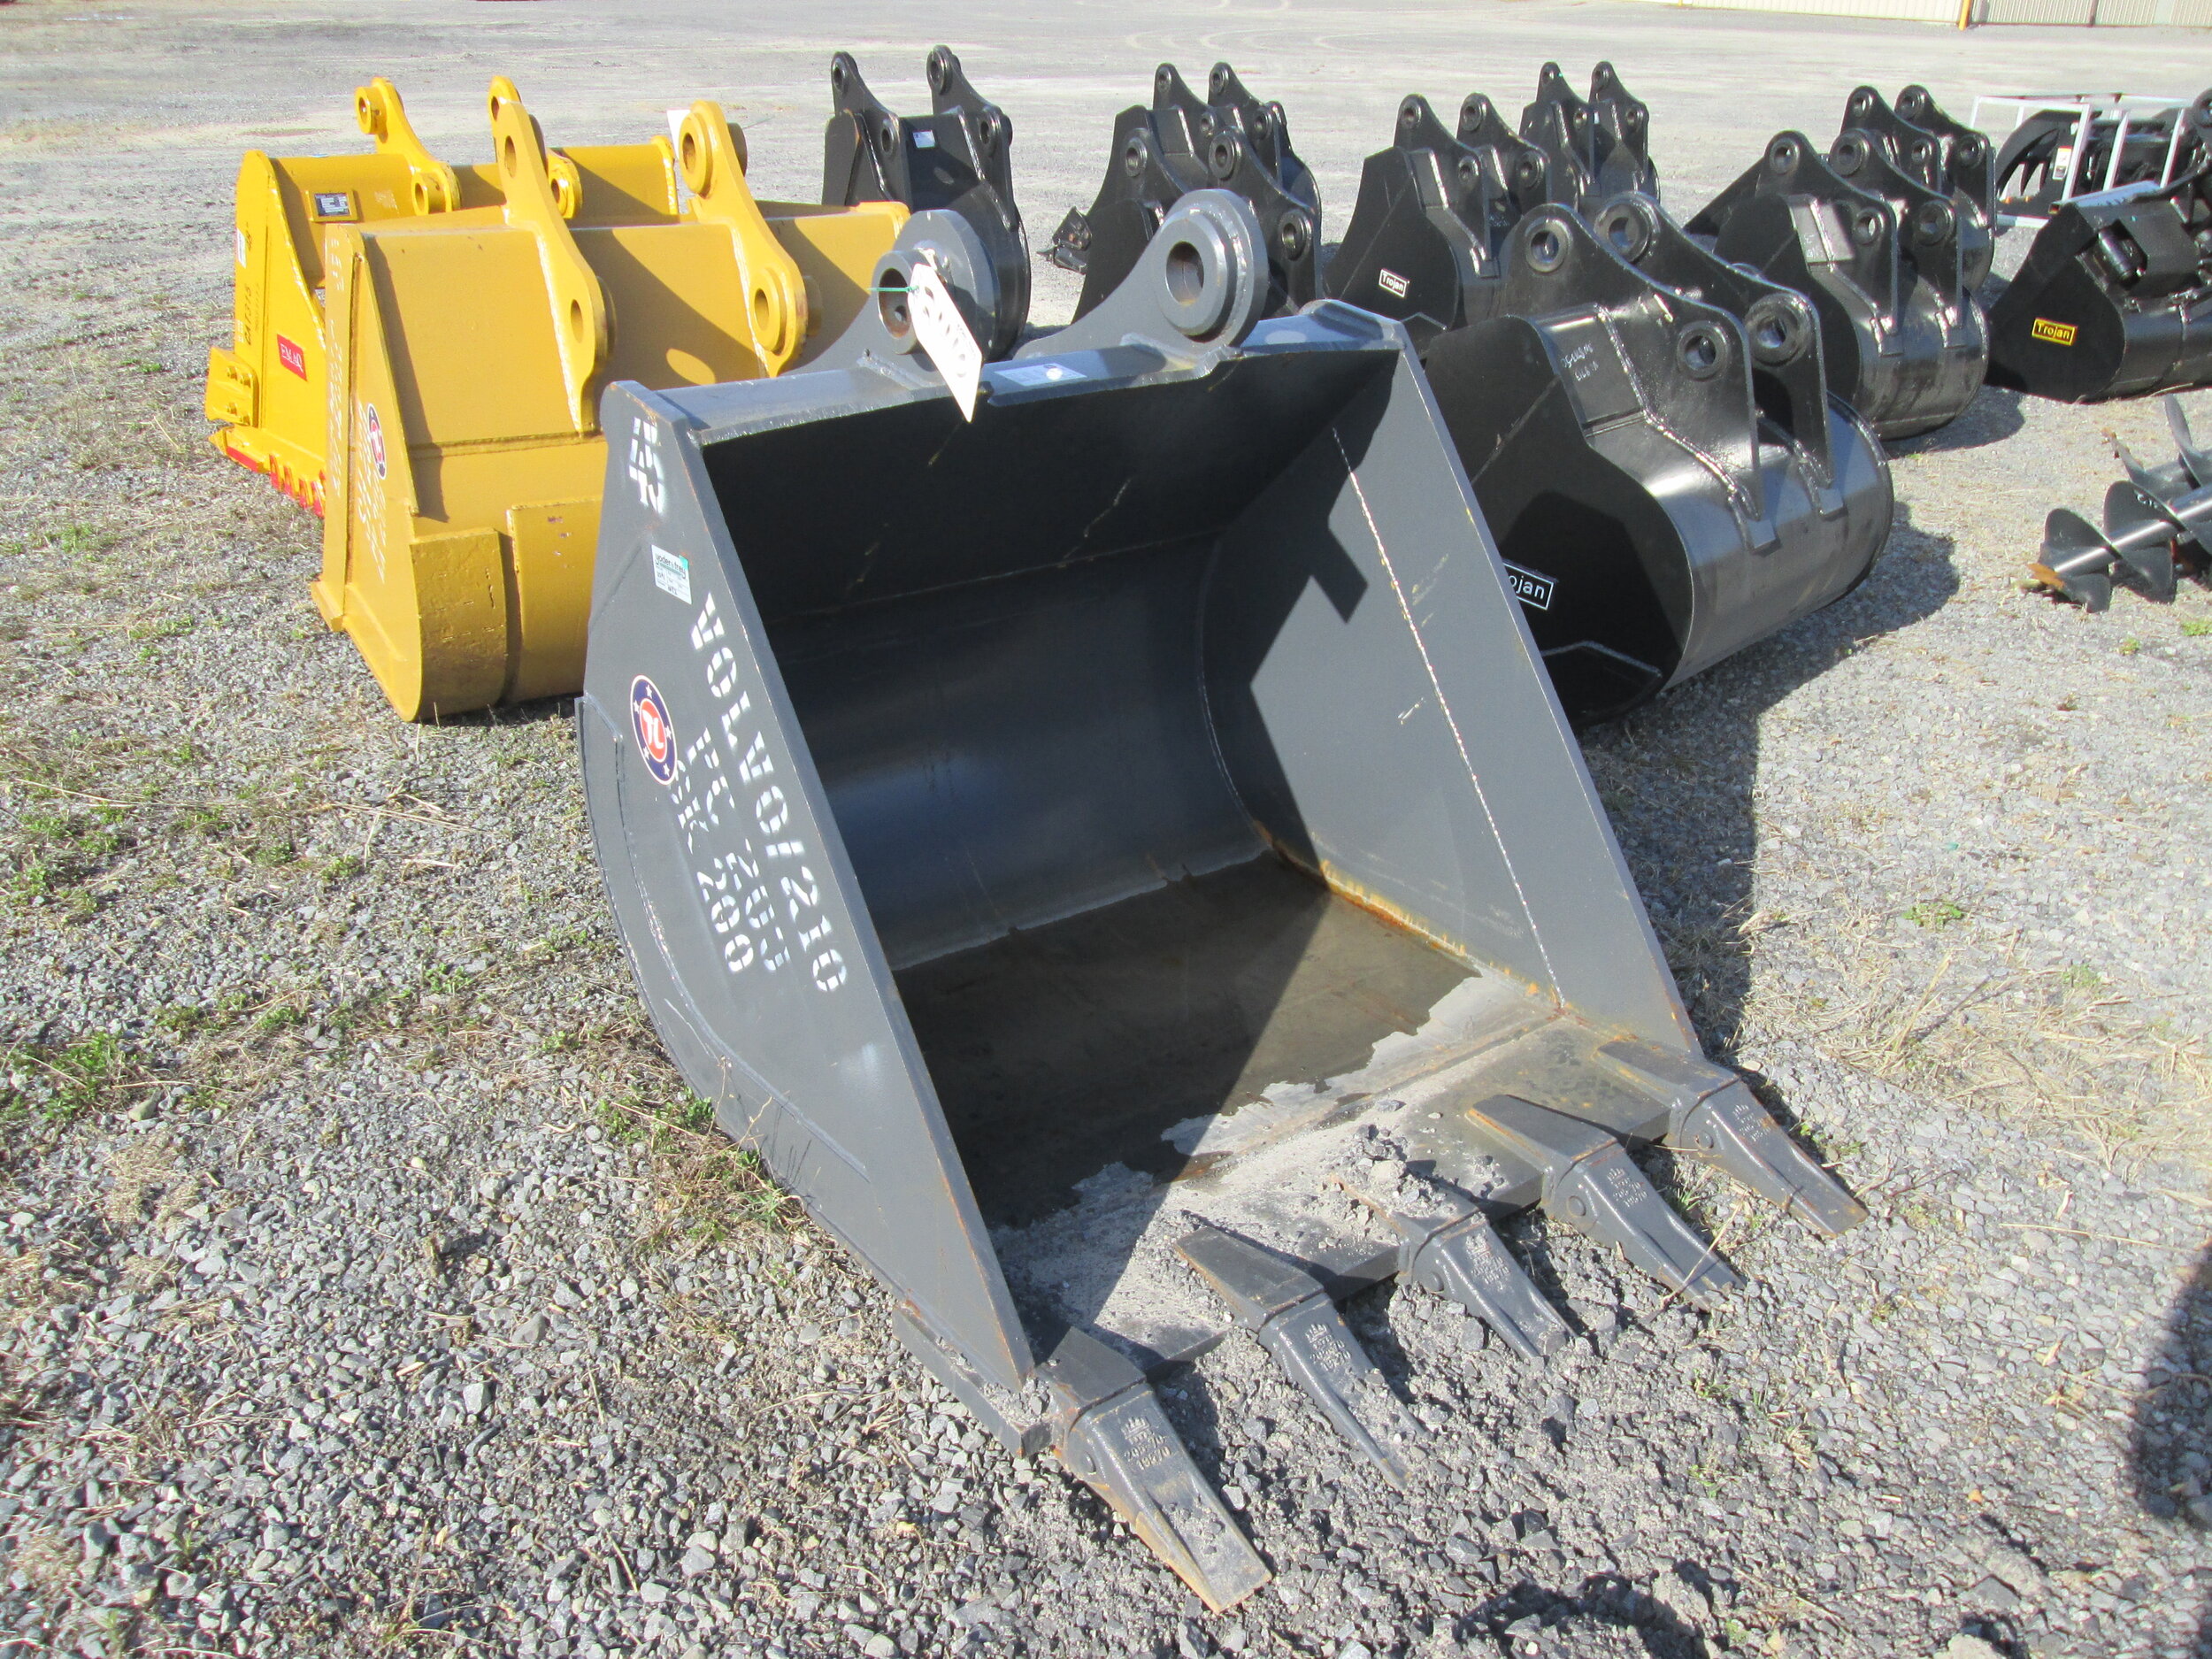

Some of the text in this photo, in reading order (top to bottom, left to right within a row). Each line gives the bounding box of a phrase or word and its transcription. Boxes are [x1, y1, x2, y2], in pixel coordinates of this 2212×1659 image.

[1382, 273, 1404, 292] Trojan
[2037, 321, 2070, 341] Trojan
[1509, 575, 1545, 600] ojan
[696, 857, 755, 974] 200
